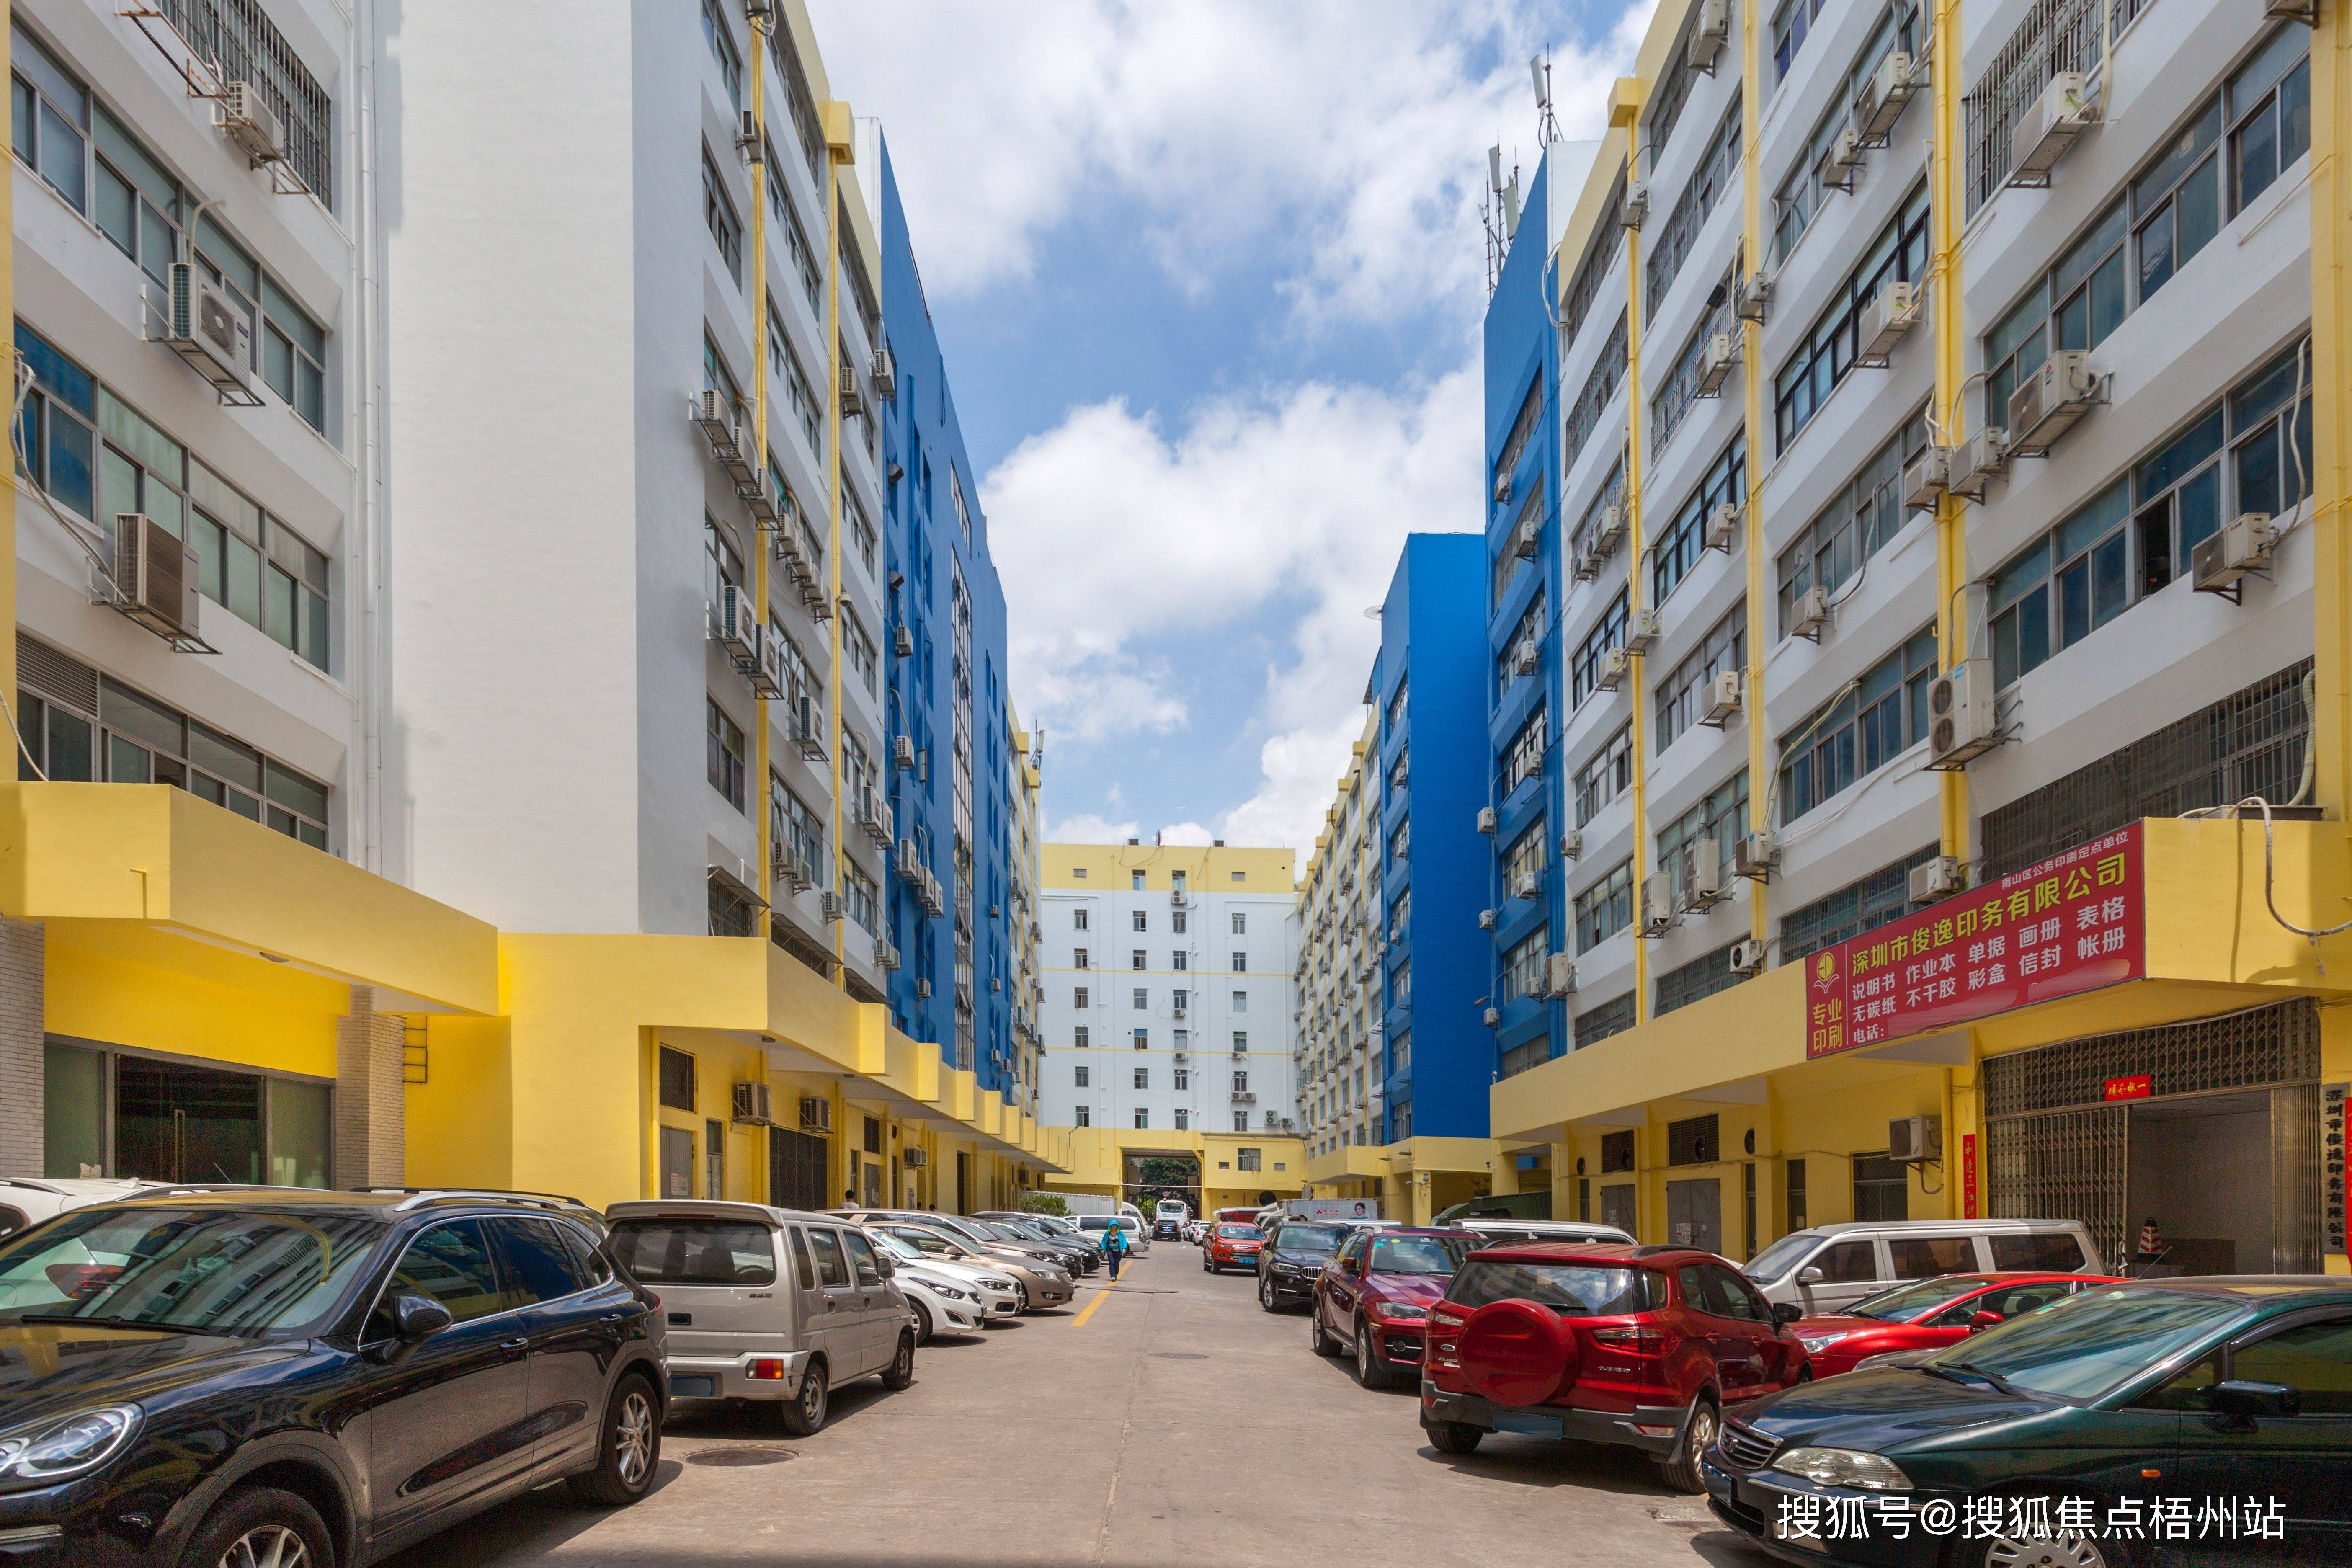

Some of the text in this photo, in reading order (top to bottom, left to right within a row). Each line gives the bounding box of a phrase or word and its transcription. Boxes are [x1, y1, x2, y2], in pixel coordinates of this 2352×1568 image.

[2002, 831, 2128, 890] 南山区公务印刷定点单位
[1852, 896, 2125, 1001] 说明书 作业本 单据 画册 表格
[1853, 852, 2125, 976] 深圳市俊逸印务有限公司
[1813, 998, 1843, 1025] 专业
[1853, 926, 2125, 1024] 无碳纸 不干胶 彩盒 信封 帐册
[1813, 1022, 1842, 1052] 印刷
